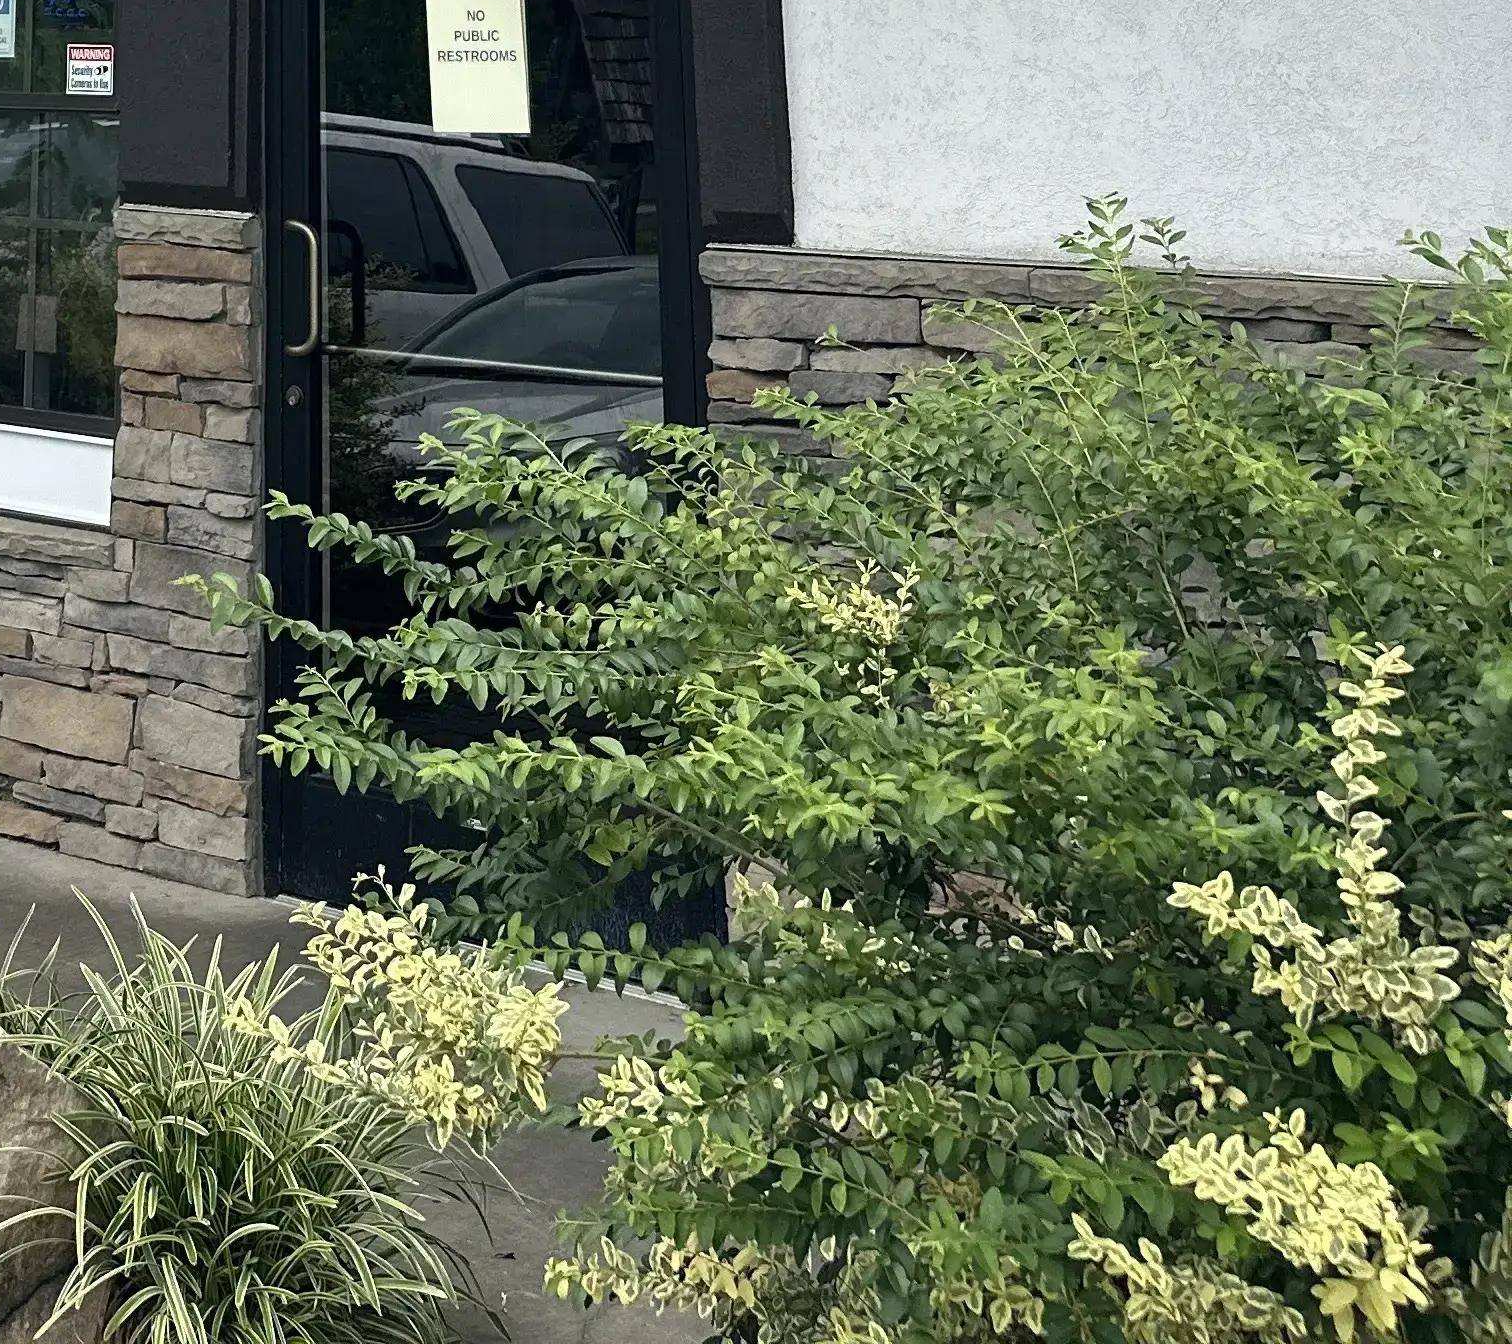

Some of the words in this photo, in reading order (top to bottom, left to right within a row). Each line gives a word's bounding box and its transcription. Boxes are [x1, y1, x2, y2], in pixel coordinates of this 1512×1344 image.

[467, 10, 485, 22] NO
[454, 30, 500, 42] PUBLIC
[70, 48, 111, 60] WARNING
[437, 50, 517, 62] RESTROOMS
